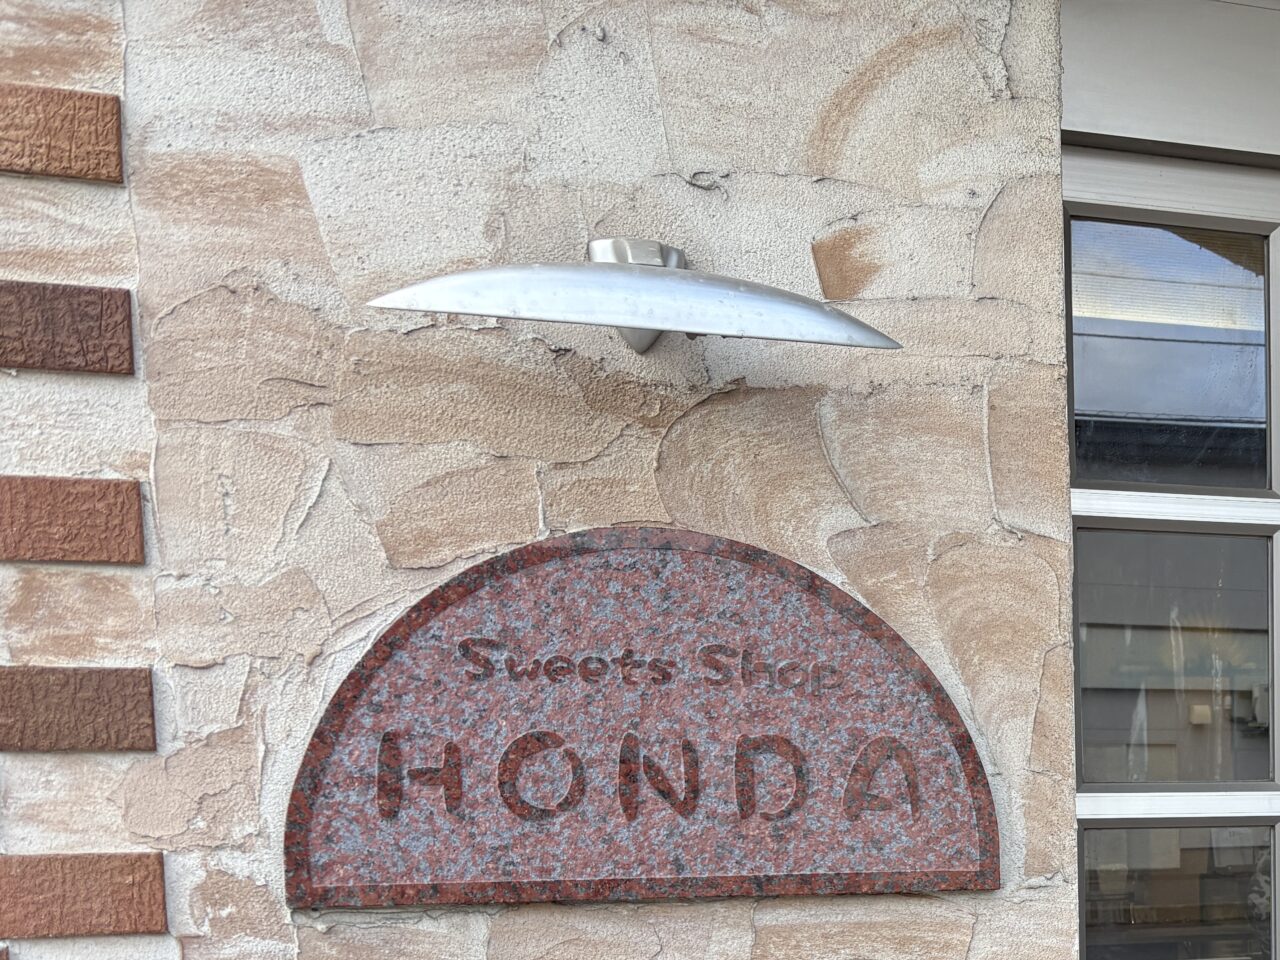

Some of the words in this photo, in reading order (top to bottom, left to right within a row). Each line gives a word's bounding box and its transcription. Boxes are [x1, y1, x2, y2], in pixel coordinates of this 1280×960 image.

[457, 637, 679, 687] Sweets
[697, 643, 844, 697] Shop
[375, 729, 922, 823] HONDA
